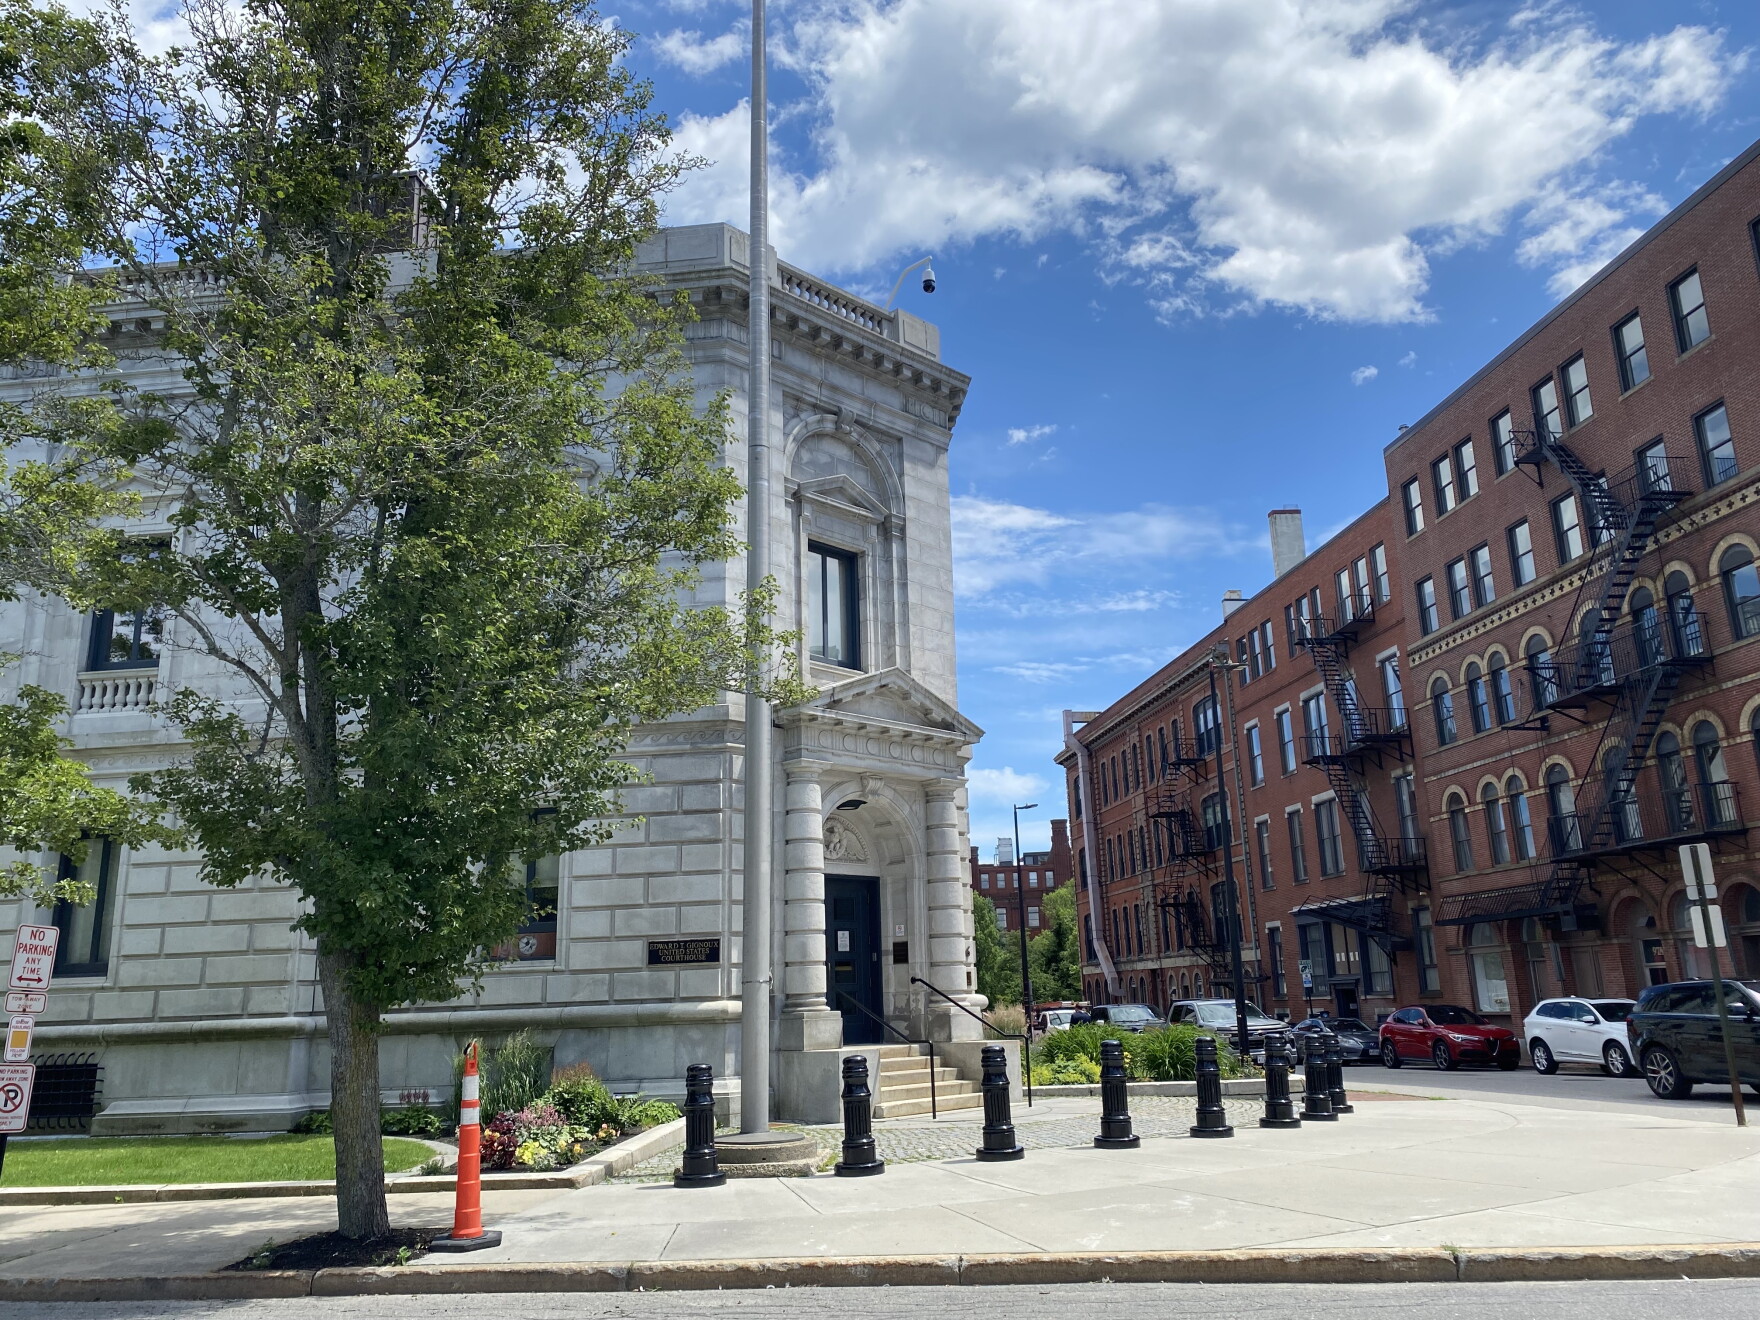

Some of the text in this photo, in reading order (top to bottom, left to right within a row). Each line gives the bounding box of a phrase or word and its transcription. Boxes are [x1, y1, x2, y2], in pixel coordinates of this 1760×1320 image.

[30, 929, 45, 941] NO
[17, 942, 53, 956] PARKING
[649, 942, 679, 950] EDWARD
[25, 957, 41, 965] ANY
[661, 954, 707, 962] COURTHOUSE
[22, 966, 41, 975] TIME
